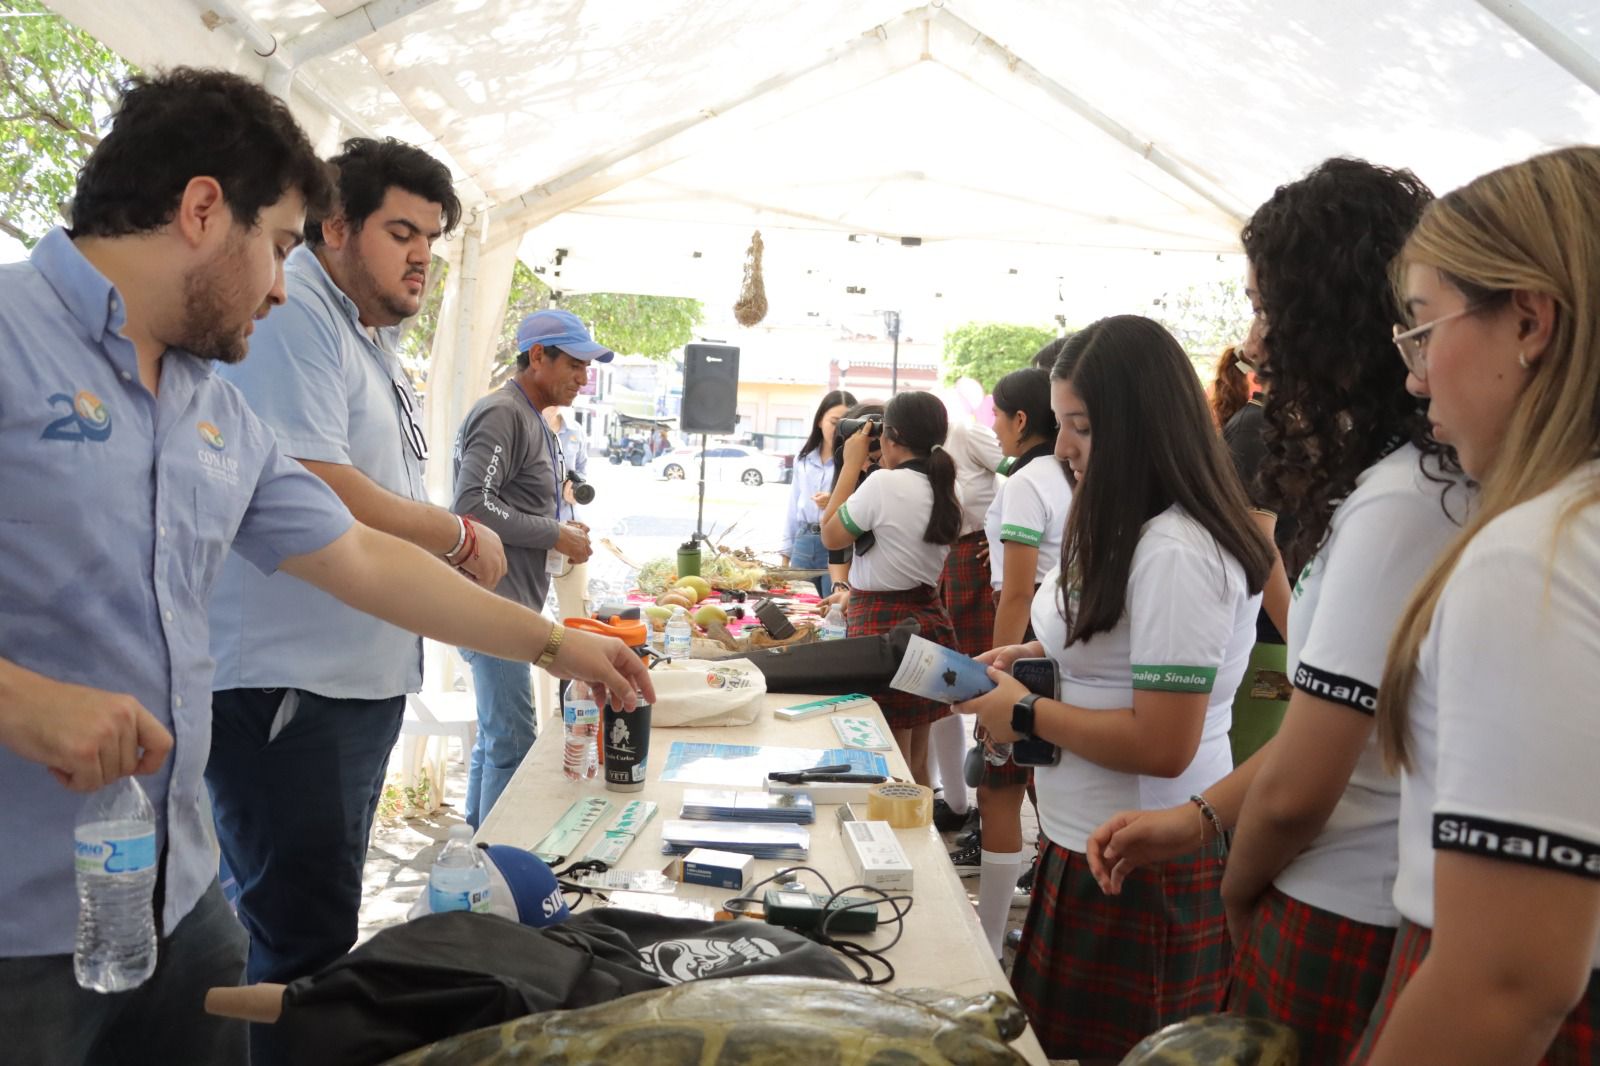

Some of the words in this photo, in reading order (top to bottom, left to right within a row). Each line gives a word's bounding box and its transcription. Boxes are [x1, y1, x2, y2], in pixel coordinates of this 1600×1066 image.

[40, 390, 112, 442] 20
[1164, 672, 1207, 685] Sinaloa
[1295, 667, 1377, 711] Sinalo
